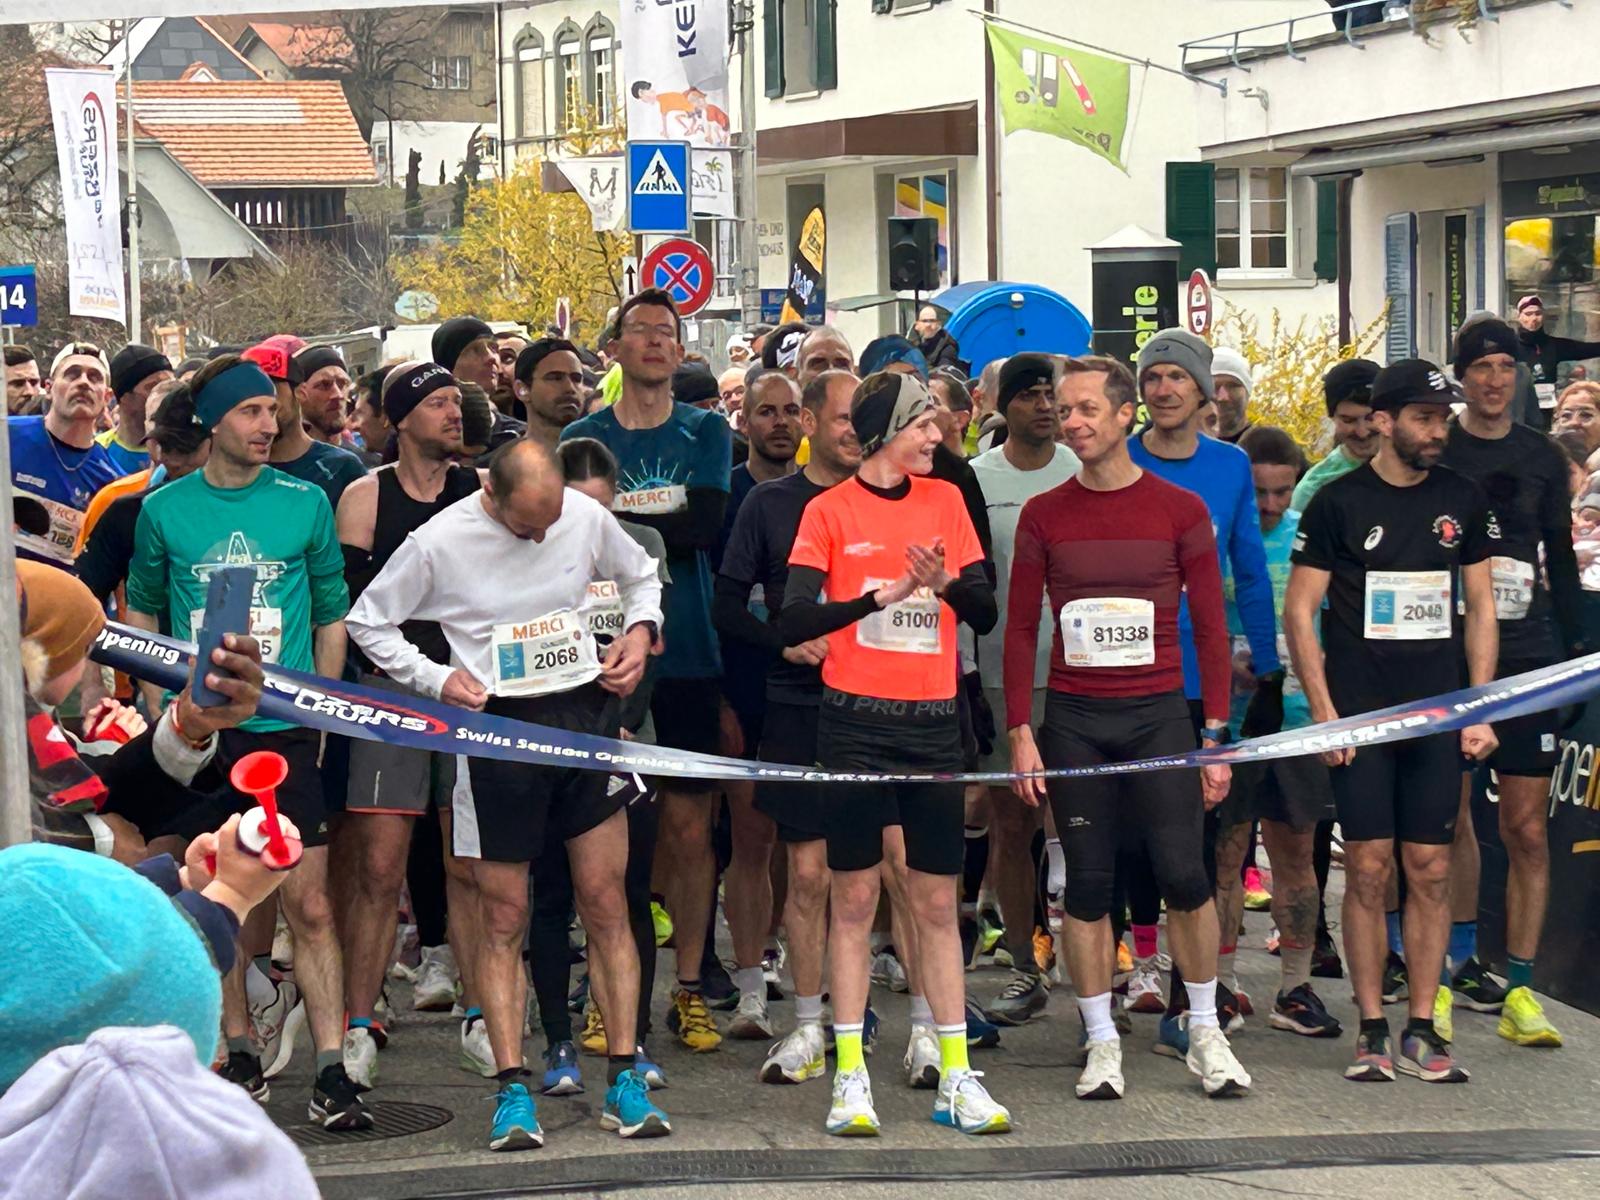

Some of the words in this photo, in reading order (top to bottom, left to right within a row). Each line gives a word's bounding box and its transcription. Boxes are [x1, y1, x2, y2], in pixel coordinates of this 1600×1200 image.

[675, 0, 697, 58] KE
[0, 283, 27, 311] 14
[621, 490, 673, 508] MERCI
[512, 617, 565, 640] MERCI
[1093, 625, 1149, 643] 81338
[534, 646, 579, 670] 2068
[853, 696, 908, 716] PRO
[455, 727, 512, 747] Swiss
